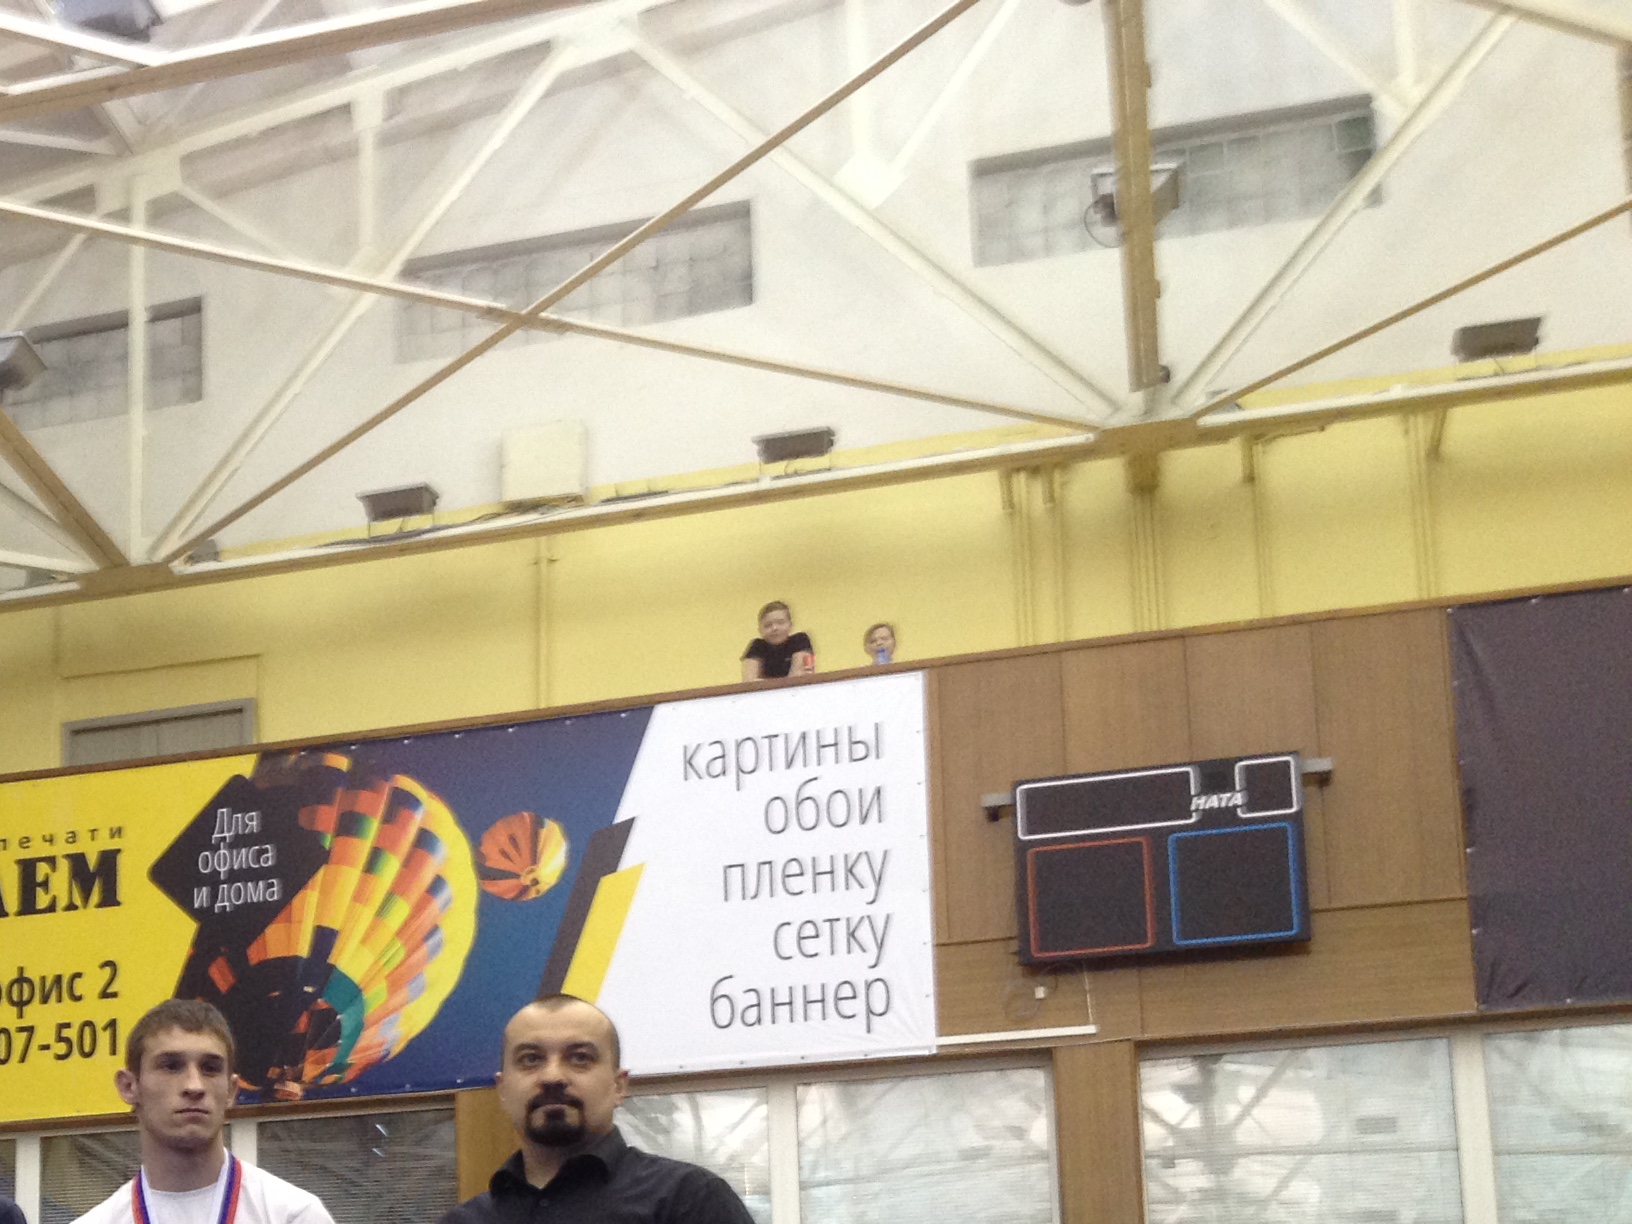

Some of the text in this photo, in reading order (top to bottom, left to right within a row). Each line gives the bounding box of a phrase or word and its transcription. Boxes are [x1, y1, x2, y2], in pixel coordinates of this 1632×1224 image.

[682, 719, 885, 785] картины
[211, 808, 261, 843] Для
[764, 778, 885, 836] обои
[197, 843, 278, 879] офиса
[721, 846, 892, 907] пленку
[192, 877, 281, 914] и дома
[772, 911, 894, 970] сетку
[97, 959, 119, 1000] 2
[709, 974, 893, 1034] баннер
